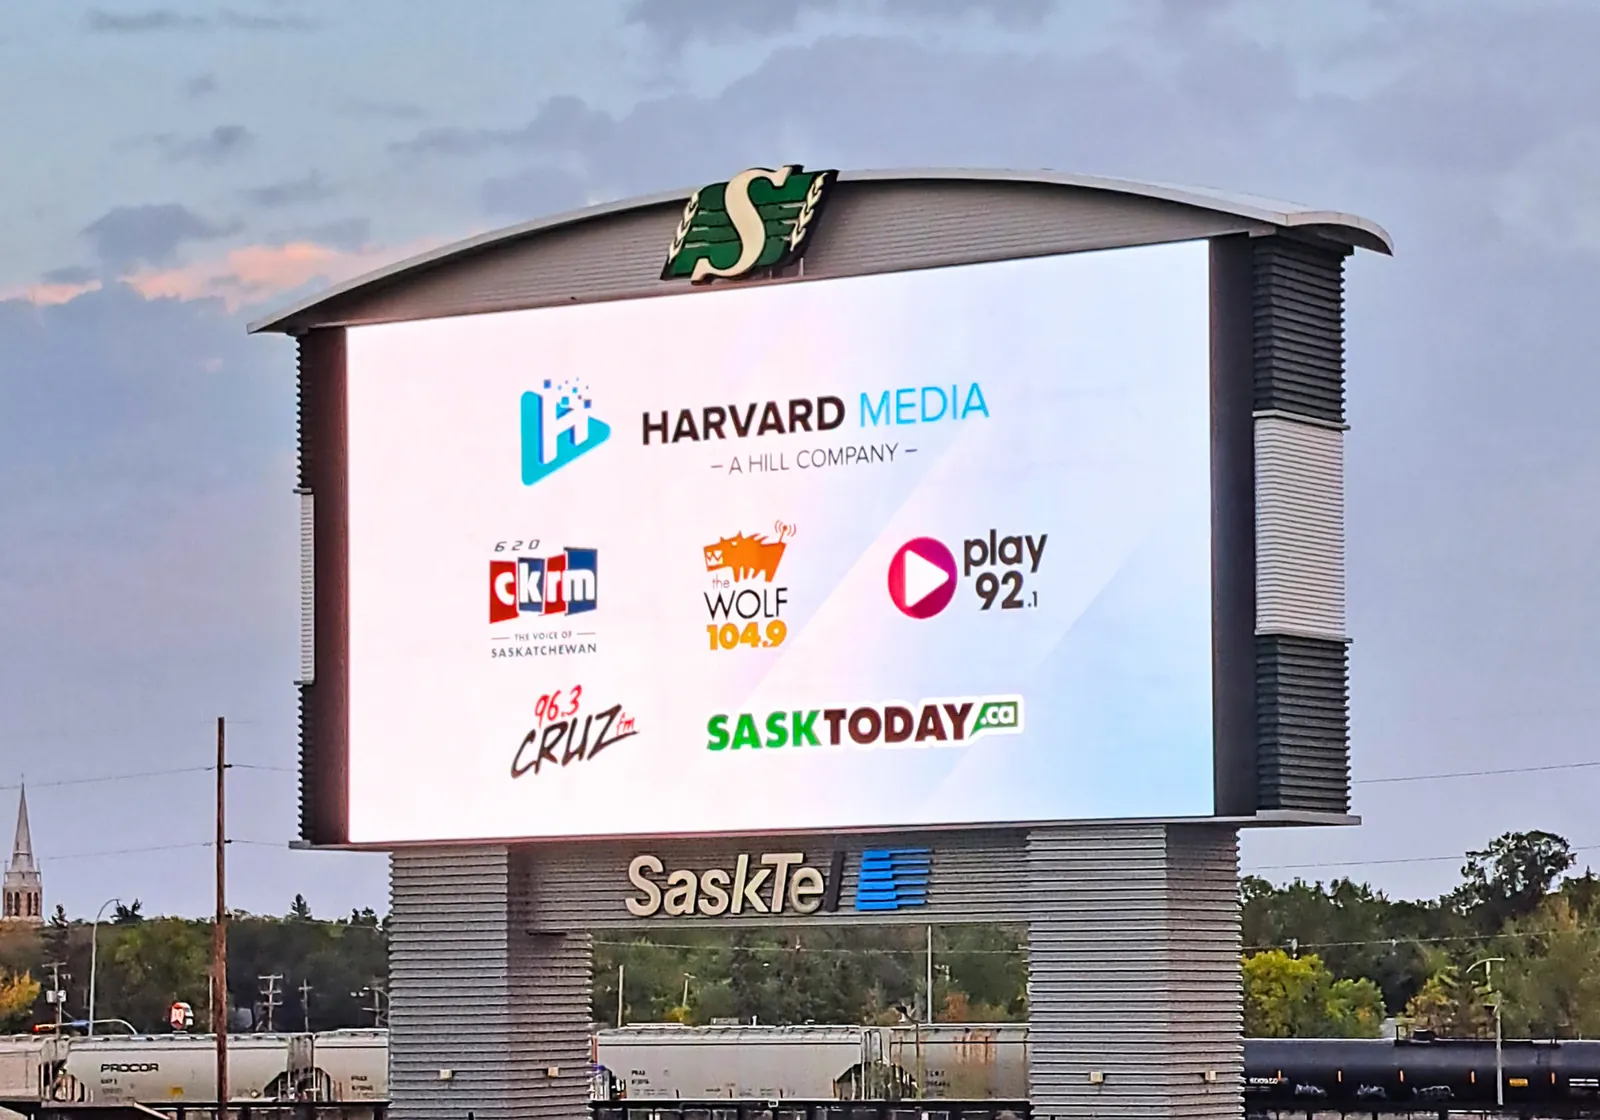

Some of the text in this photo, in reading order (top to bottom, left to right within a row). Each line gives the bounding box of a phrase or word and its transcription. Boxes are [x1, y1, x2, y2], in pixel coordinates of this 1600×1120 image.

[641, 382, 991, 446] HARVARD MEDIA
[728, 443, 899, 475] A HILL COMPANY
[494, 538, 541, 553] 620
[963, 528, 1048, 577] play
[494, 562, 597, 606] ckrm
[712, 574, 730, 590] the
[975, 570, 1039, 611] 92.1
[703, 587, 788, 620] WOLF
[491, 643, 597, 659] SASKATCHEWAN
[514, 630, 573, 642] THE VOICE OF
[706, 619, 787, 651] 104.9
[535, 684, 582, 729] 96.3
[510, 702, 640, 779] CRUZ
[624, 850, 846, 917] SaskTel
[100, 1063, 159, 1073] PROCOR
